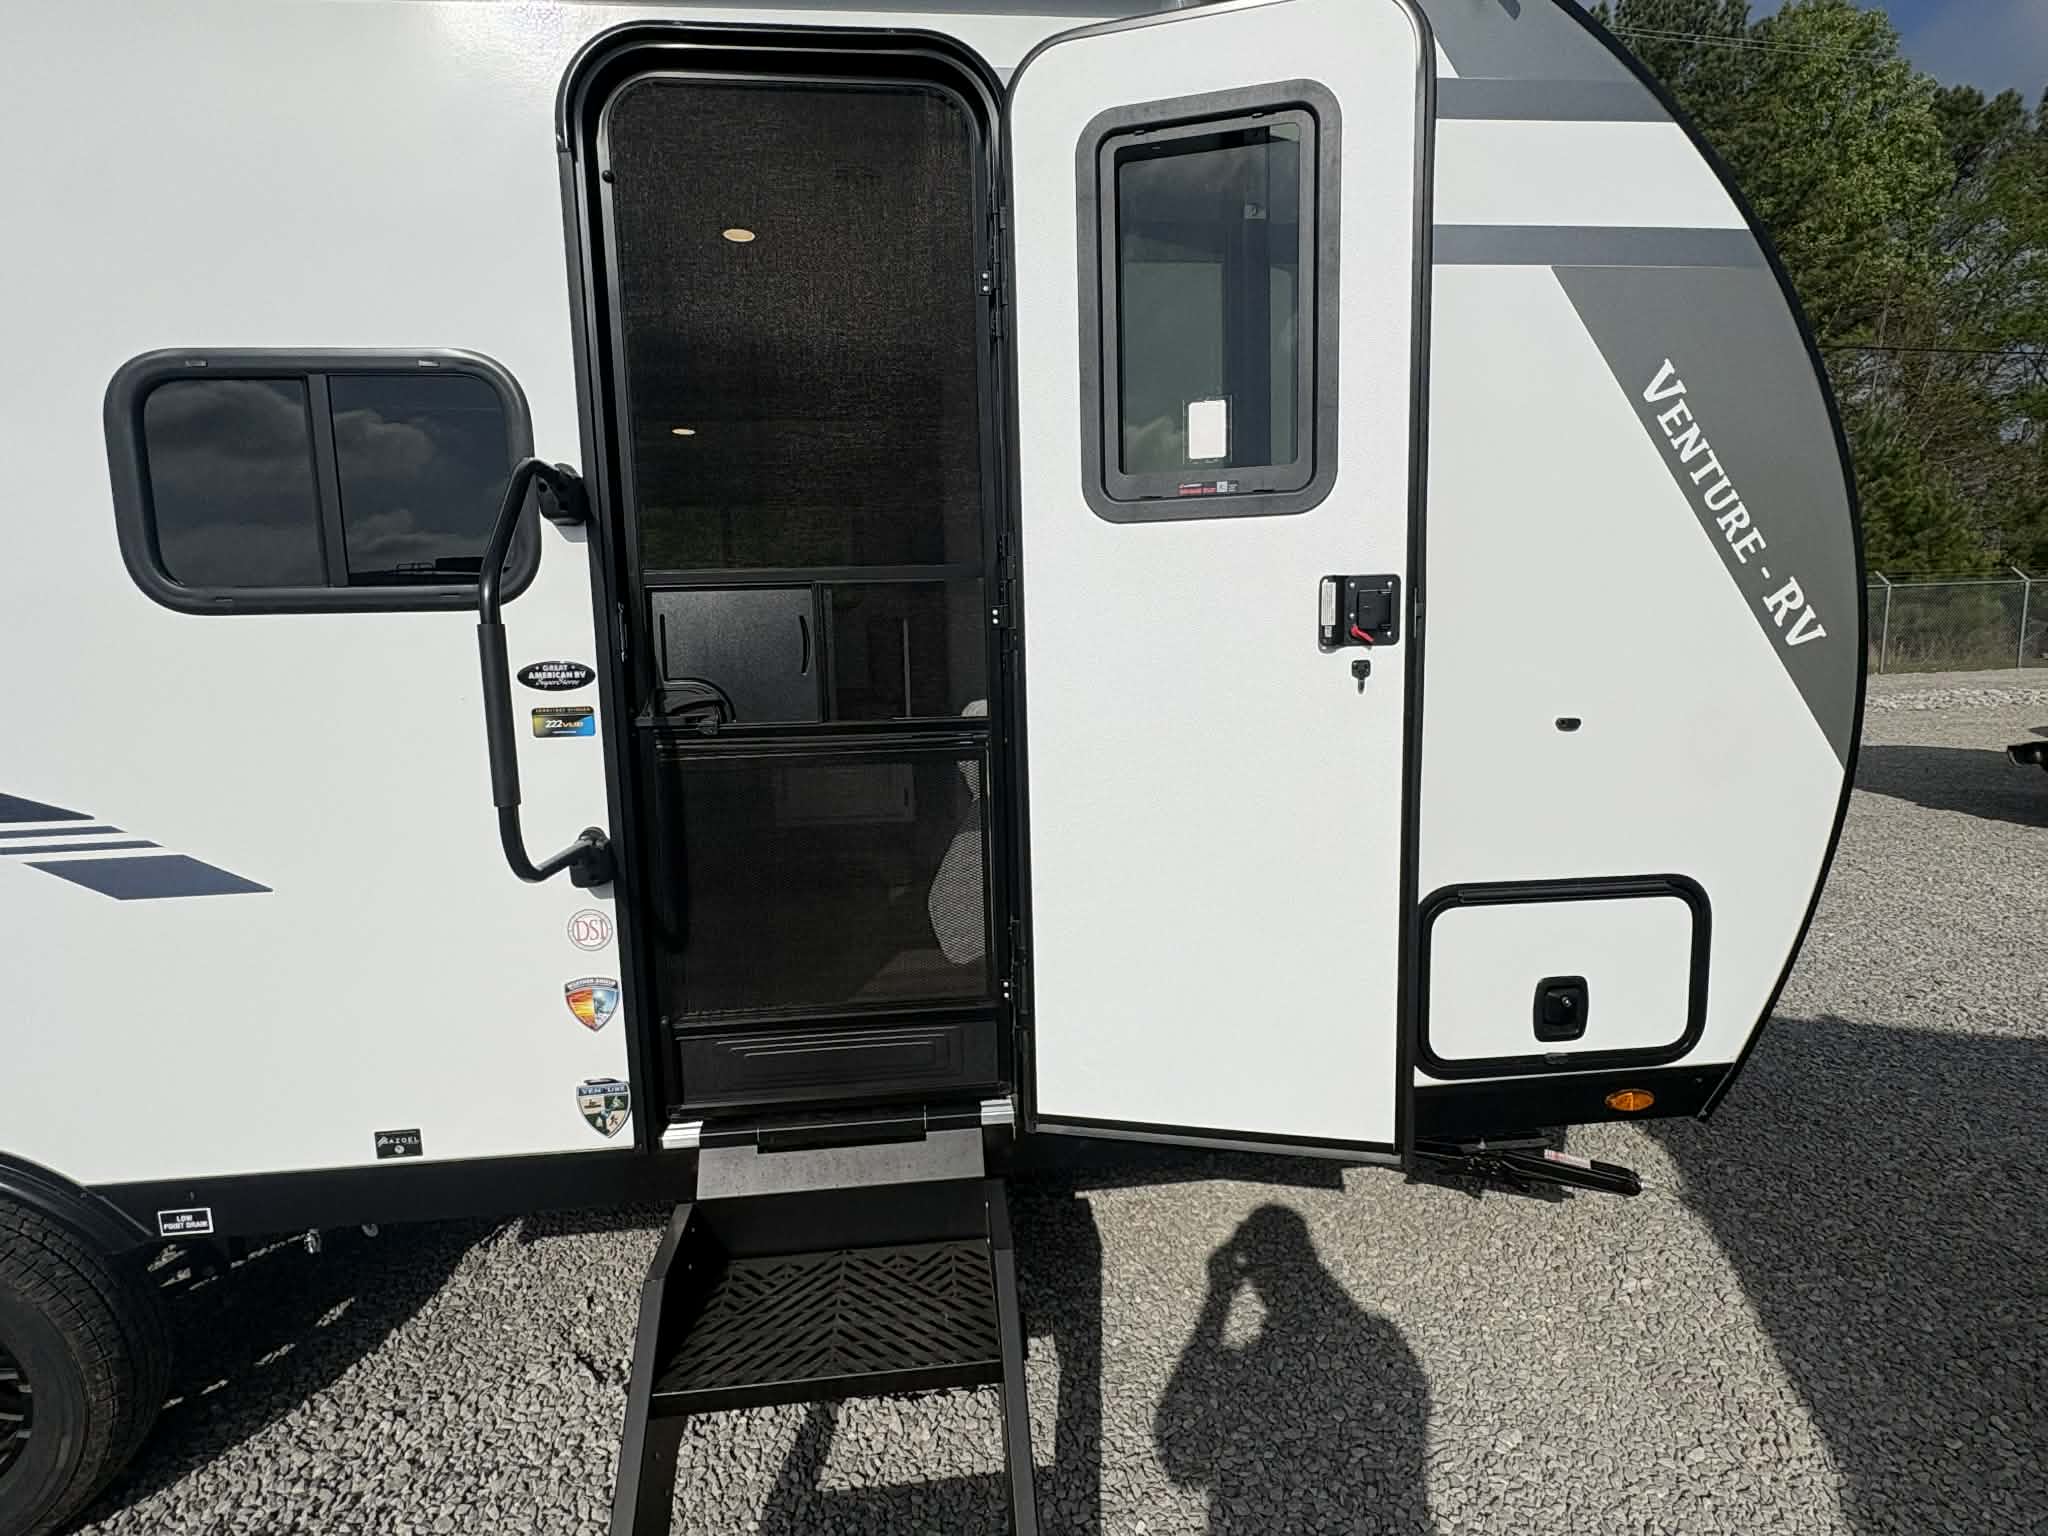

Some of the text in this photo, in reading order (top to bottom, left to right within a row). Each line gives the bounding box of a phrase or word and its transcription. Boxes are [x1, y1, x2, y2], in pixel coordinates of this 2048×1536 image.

[1641, 357, 1768, 564] VENTURE
[1762, 576, 1828, 649] RV
[542, 664, 568, 672] GREAT
[528, 670, 586, 679] AMERICAN RV
[176, 1214, 193, 1222] LOW
[163, 1220, 208, 1230] POINT DRAIN
